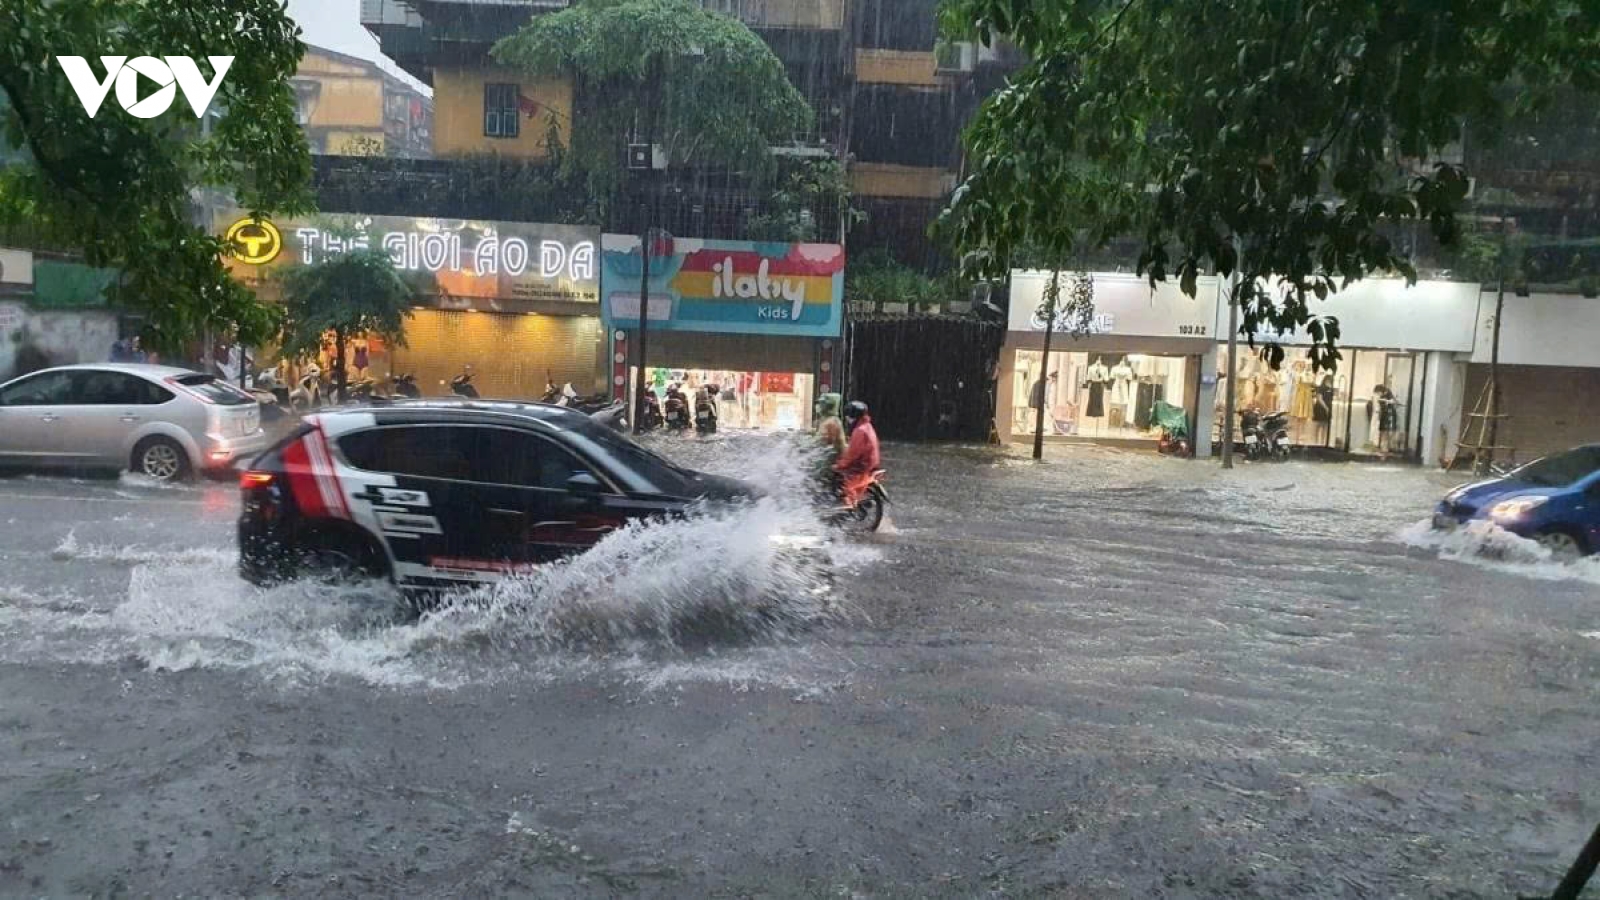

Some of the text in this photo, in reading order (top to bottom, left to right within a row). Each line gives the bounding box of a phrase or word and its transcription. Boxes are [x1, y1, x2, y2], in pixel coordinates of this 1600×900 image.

[540, 240, 595, 280] DA
[712, 255, 805, 321] ilaby
[758, 306, 789, 319] Kids
[1179, 325, 1206, 335] 103 A2
